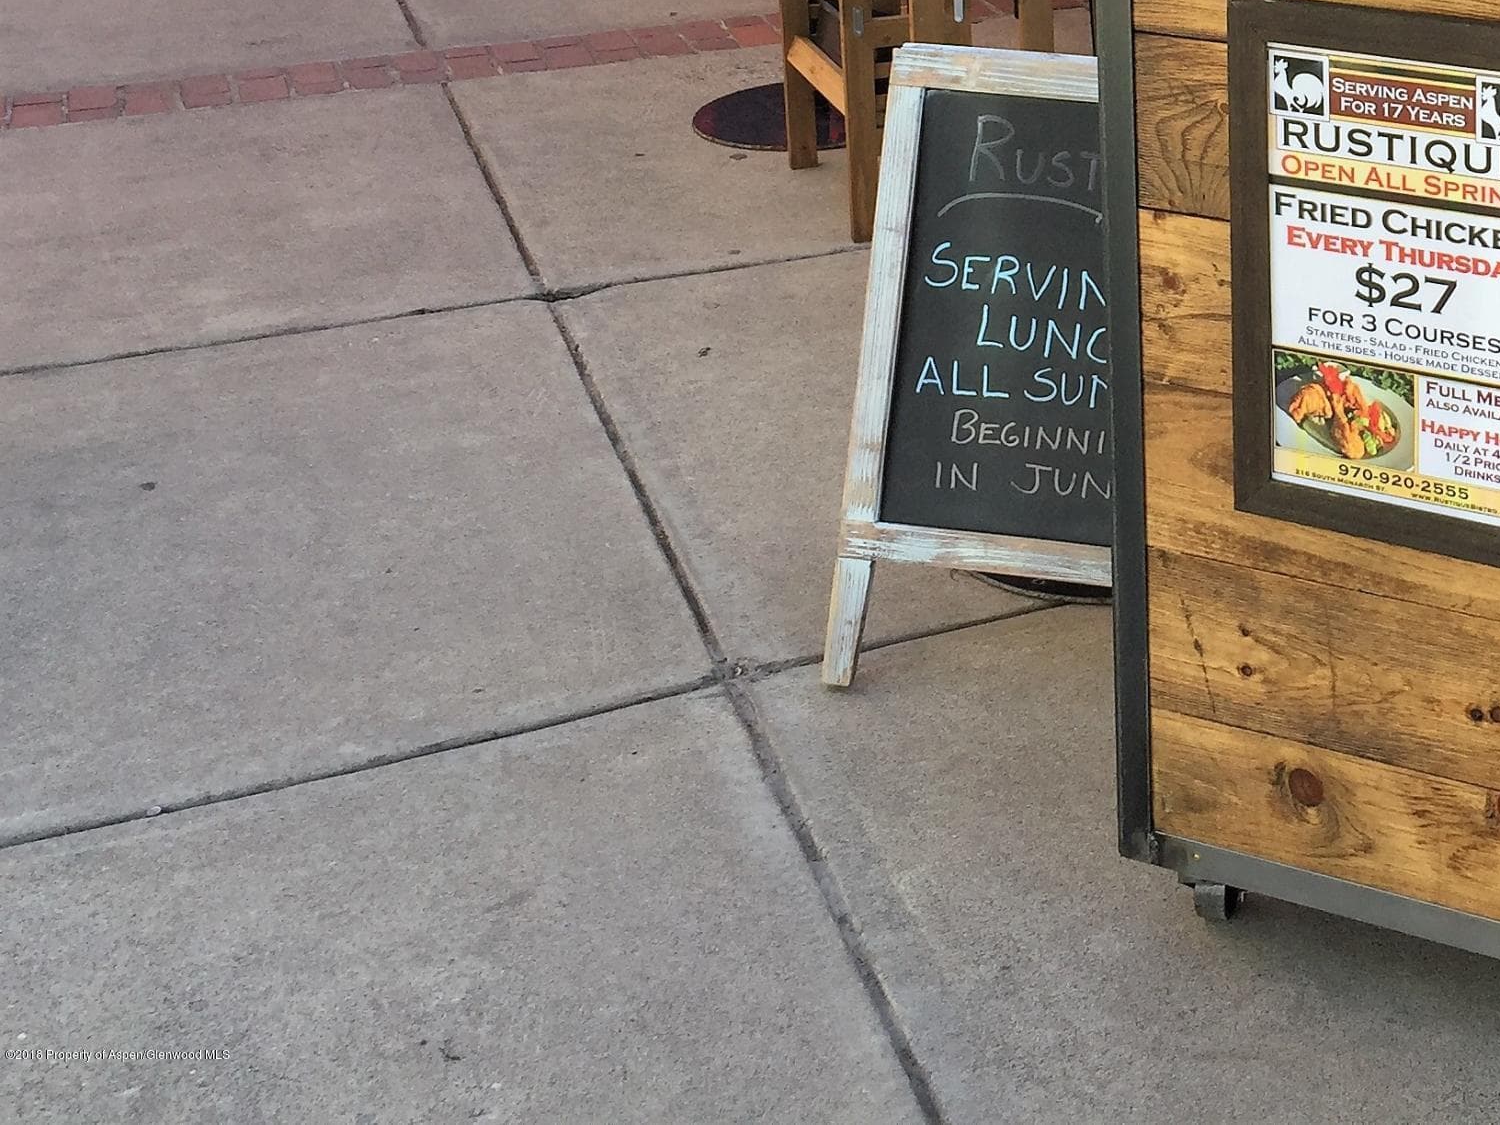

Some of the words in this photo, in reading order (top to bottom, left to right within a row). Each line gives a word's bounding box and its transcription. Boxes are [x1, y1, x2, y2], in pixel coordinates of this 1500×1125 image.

[1332, 77, 1408, 100] SERVING
[1412, 87, 1473, 110] ASPEN
[1341, 97, 1376, 116] FOR
[1382, 102, 1402, 119] 17
[1407, 106, 1466, 127] YEARS
[969, 114, 1100, 191] RUST
[1281, 154, 1355, 184] OPEN
[1364, 167, 1416, 192] ALL
[1275, 191, 1372, 229] FRIED
[1287, 225, 1375, 257] EVERY
[925, 241, 1106, 310] SERVIN
[1355, 263, 1457, 315] $27
[977, 305, 1107, 364] LUNC
[1308, 307, 1354, 329] FOR
[1362, 314, 1377, 332] 3
[1297, 336, 1319, 348] ALL
[1322, 339, 1343, 351] THE
[1345, 345, 1376, 357] SIDES
[1385, 350, 1423, 365] HOUSE
[1426, 359, 1458, 371] MADE
[1306, 326, 1362, 344] STARTERS
[1370, 337, 1406, 351] SALAD
[1415, 345, 1449, 359] FRIED
[916, 357, 1009, 398] ALL
[1425, 381, 1471, 402] FULL
[1426, 398, 1459, 412] ALSO
[951, 408, 1105, 455] BEGINNI
[1421, 418, 1480, 443] HAPPY
[1434, 438, 1472, 455] DAILY
[1474, 446, 1490, 457] AT
[1445, 452, 1471, 465] 1/2
[935, 462, 978, 491] IN
[1010, 464, 1111, 500] JUN
[1312, 472, 1336, 482] SOUTH
[1338, 464, 1469, 500] 970-920-2555
[1454, 465, 1500, 484] DRINKS
